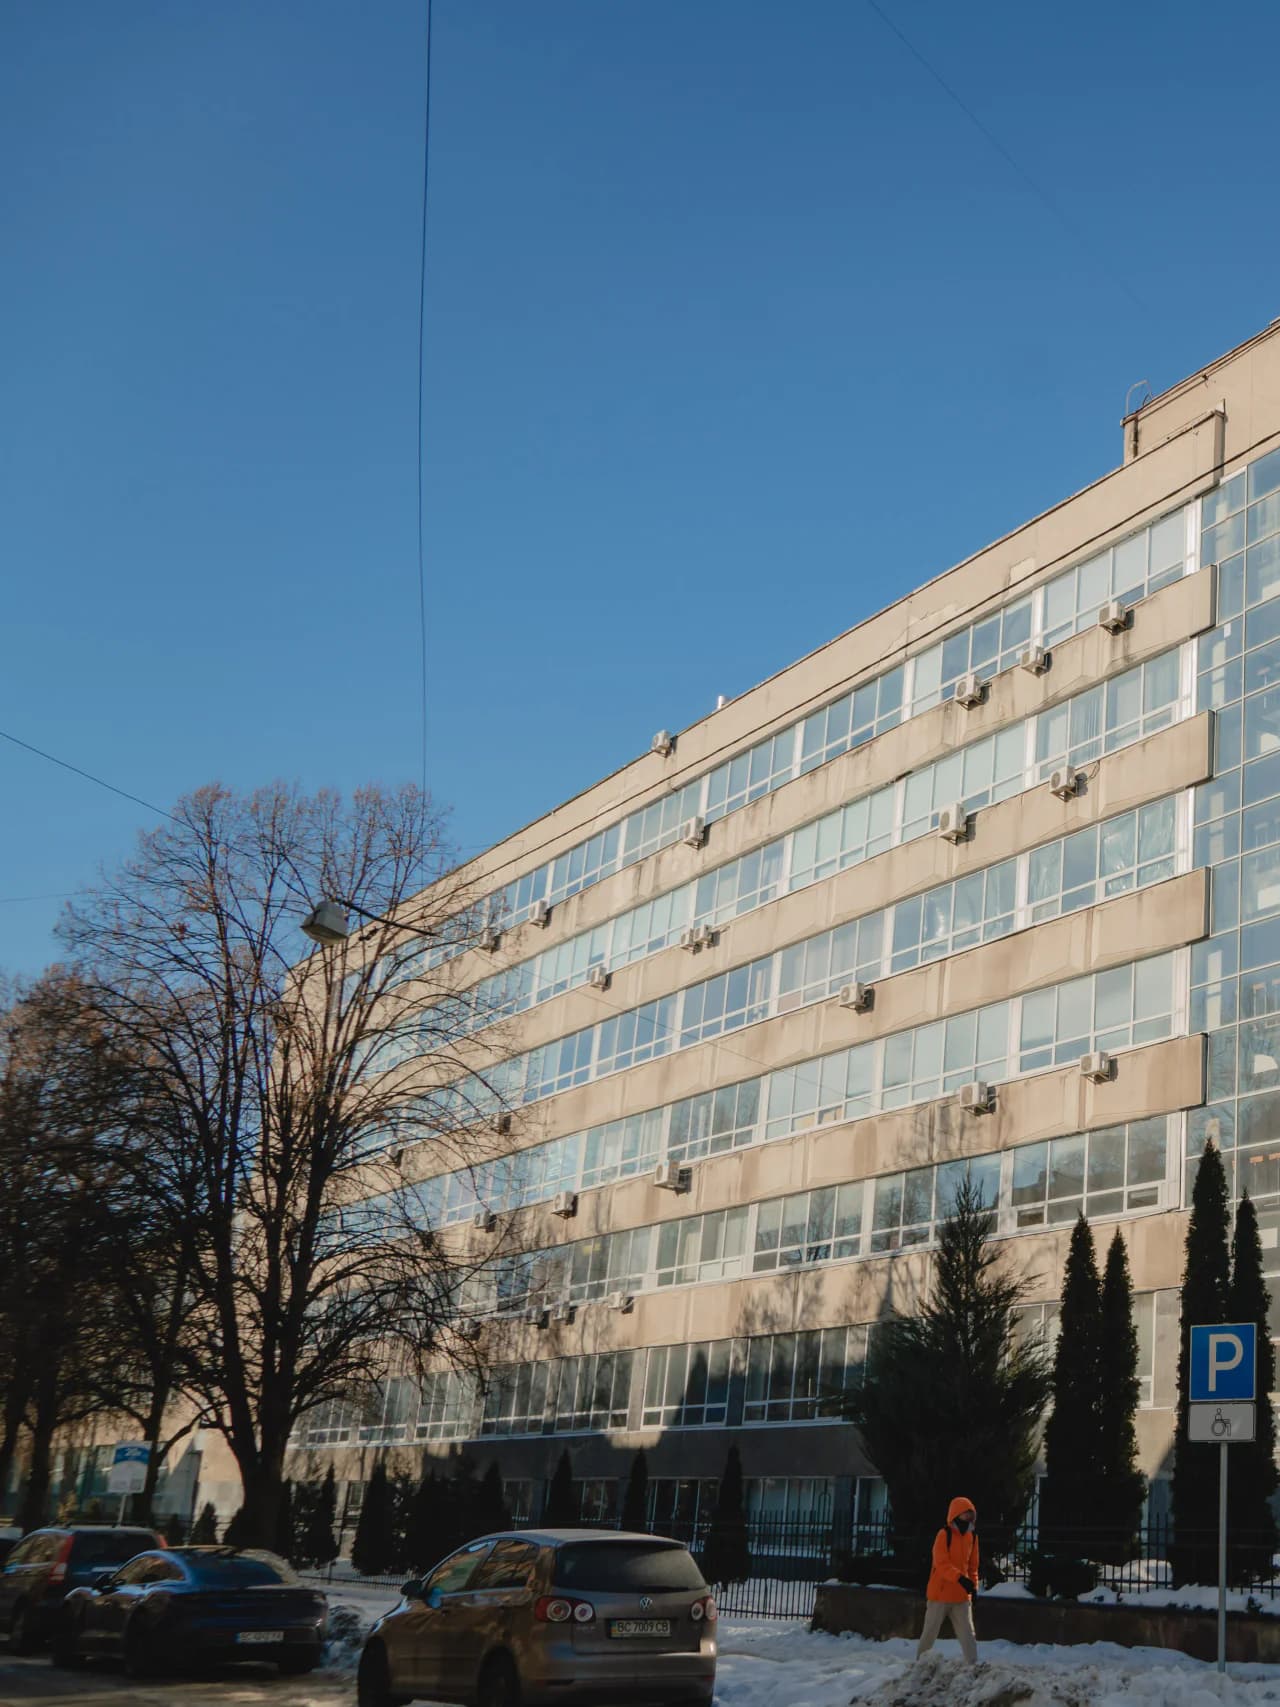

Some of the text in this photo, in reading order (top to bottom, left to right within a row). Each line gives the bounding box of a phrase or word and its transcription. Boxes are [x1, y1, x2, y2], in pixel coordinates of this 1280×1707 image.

[1208, 1333, 1244, 1392] P
[617, 1622, 669, 1633] BC 7009 CB
